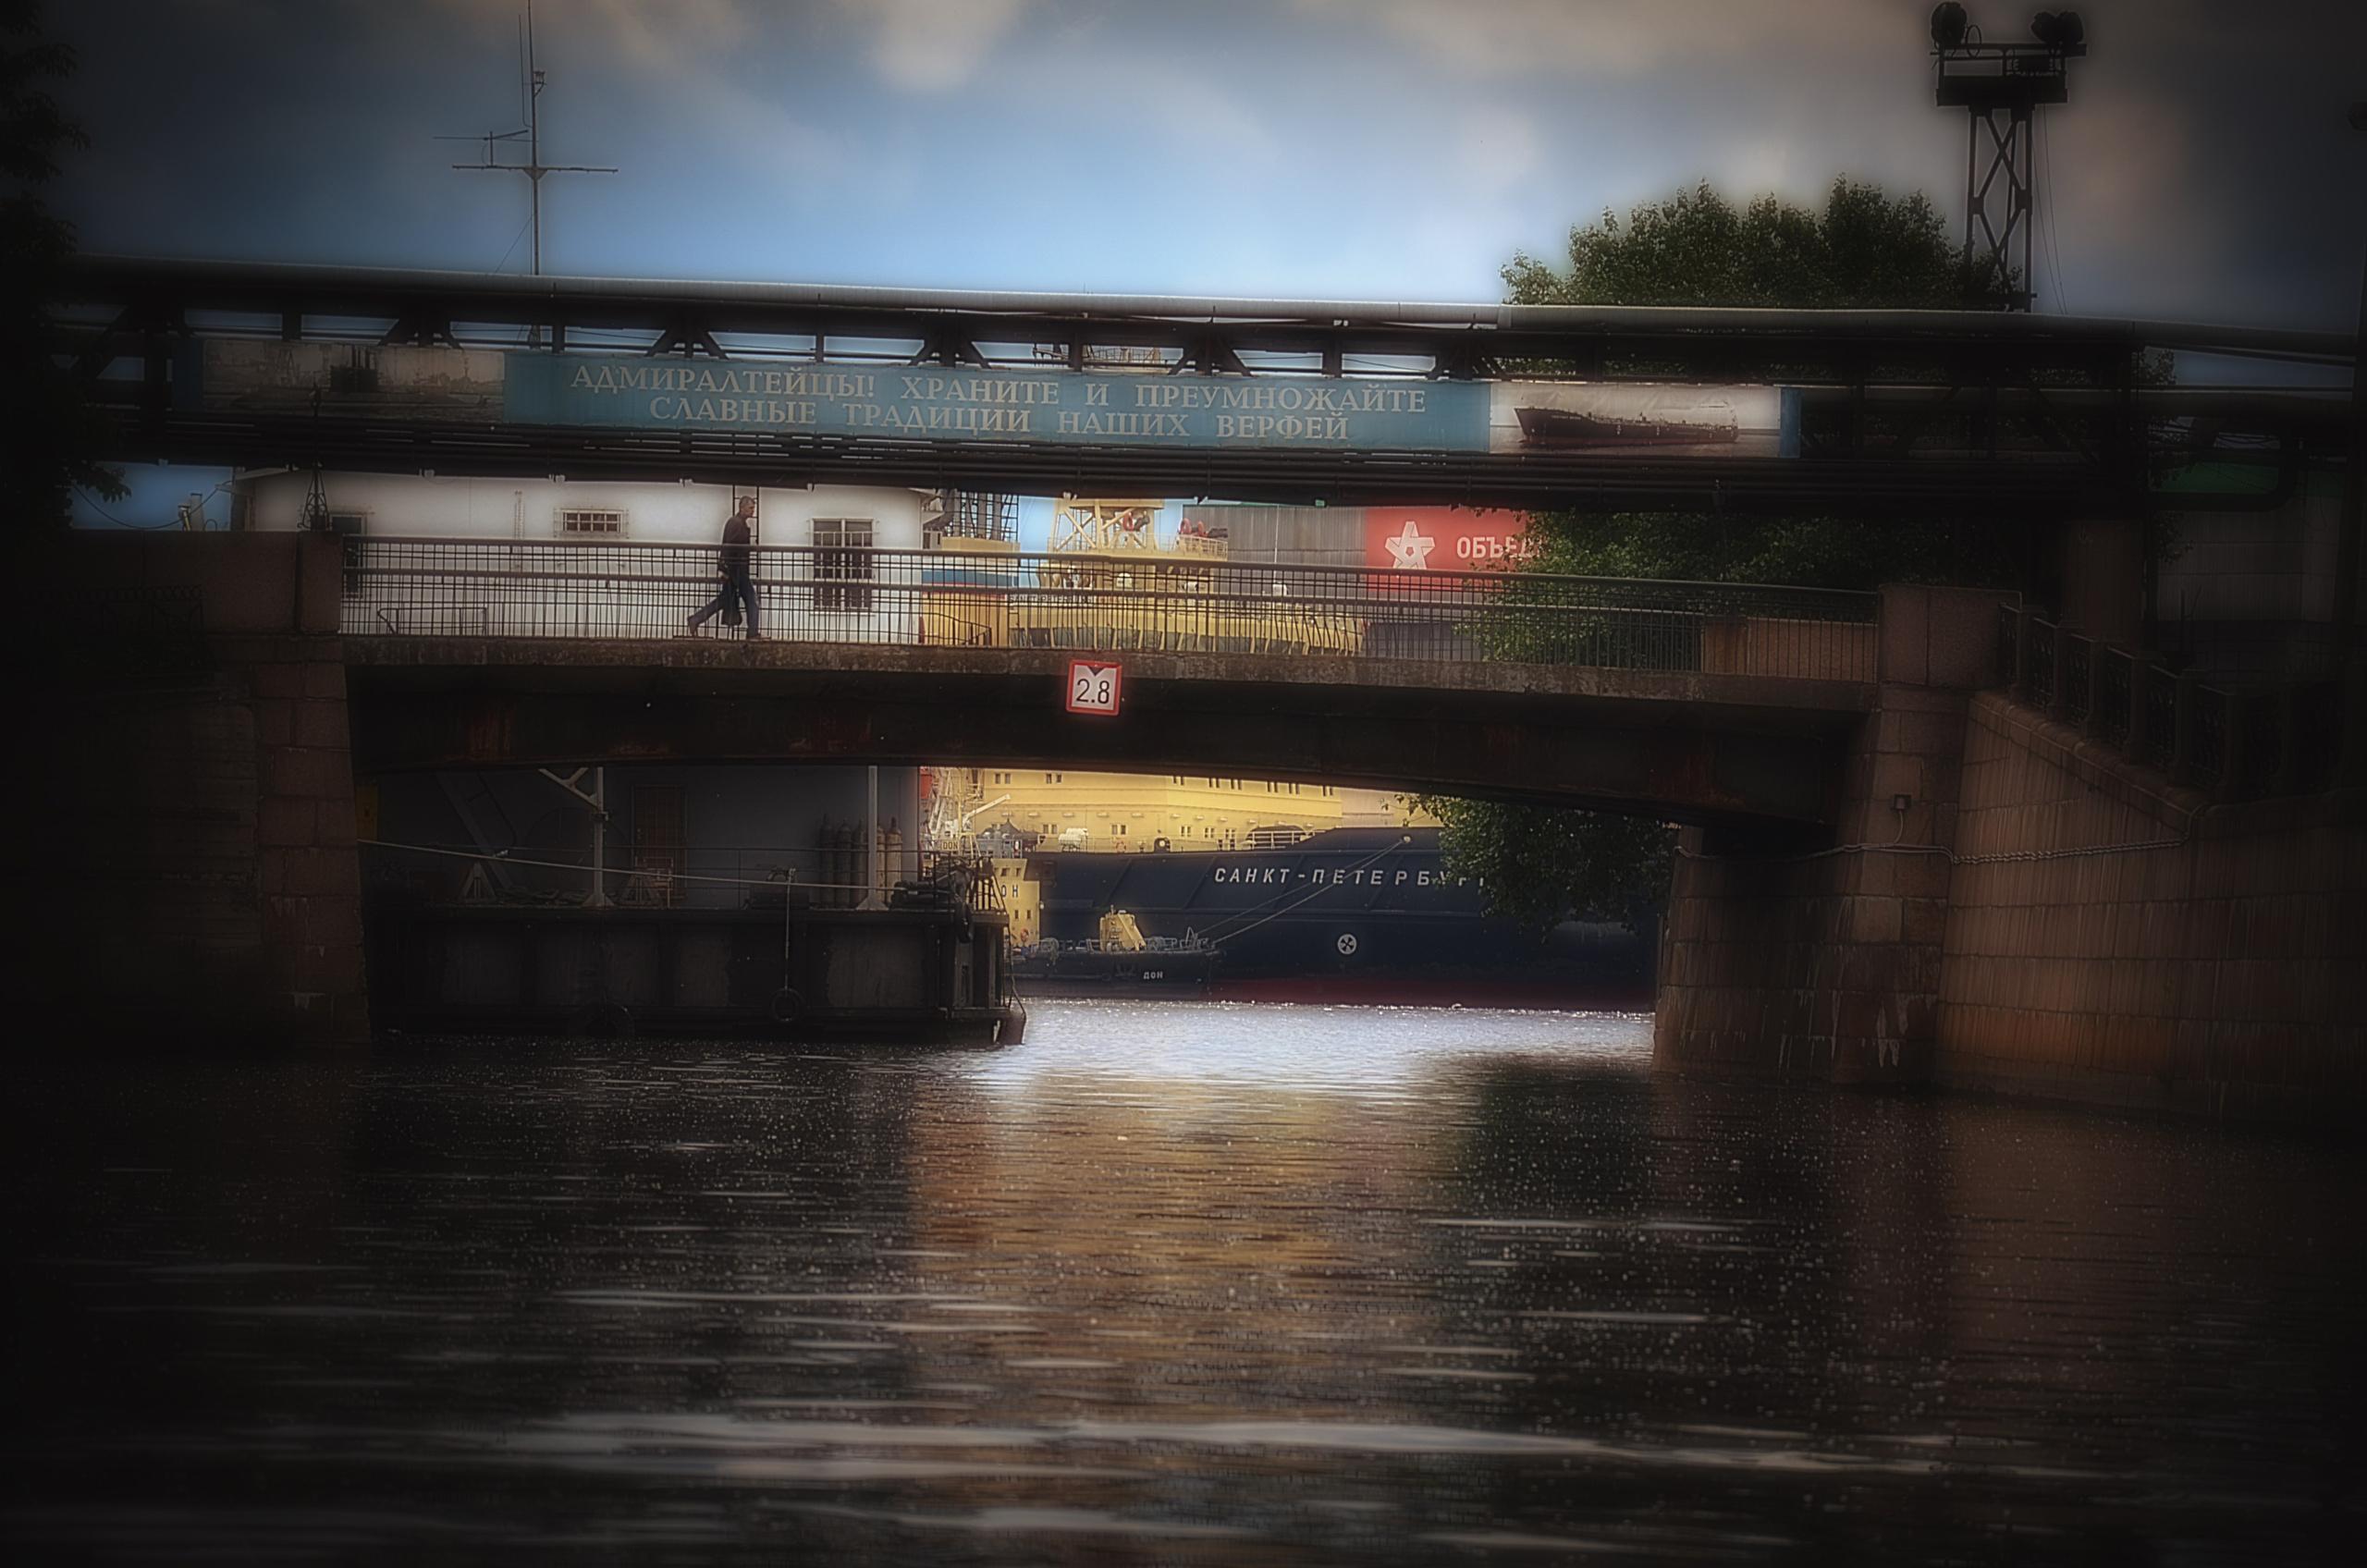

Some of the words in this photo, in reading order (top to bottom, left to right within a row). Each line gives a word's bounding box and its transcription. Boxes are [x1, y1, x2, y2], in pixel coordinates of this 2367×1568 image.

[570, 365, 875, 401] АДМИРАЛТЕЙЦЫ!
[901, 376, 1059, 404] ХРАНИТЕ
[1085, 384, 1109, 406] И
[1134, 384, 1425, 412] ПРЕУМНОЖАЙТЕ
[649, 397, 816, 424] СЛАВНЫЕ
[842, 404, 1031, 435] ТРАДИЦИИ
[1057, 411, 1190, 436] НАШИХ
[1216, 411, 1348, 439] ВЕРФЕЙ
[1076, 678, 1110, 704] 2.8
[1143, 971, 1164, 980] ДОН
